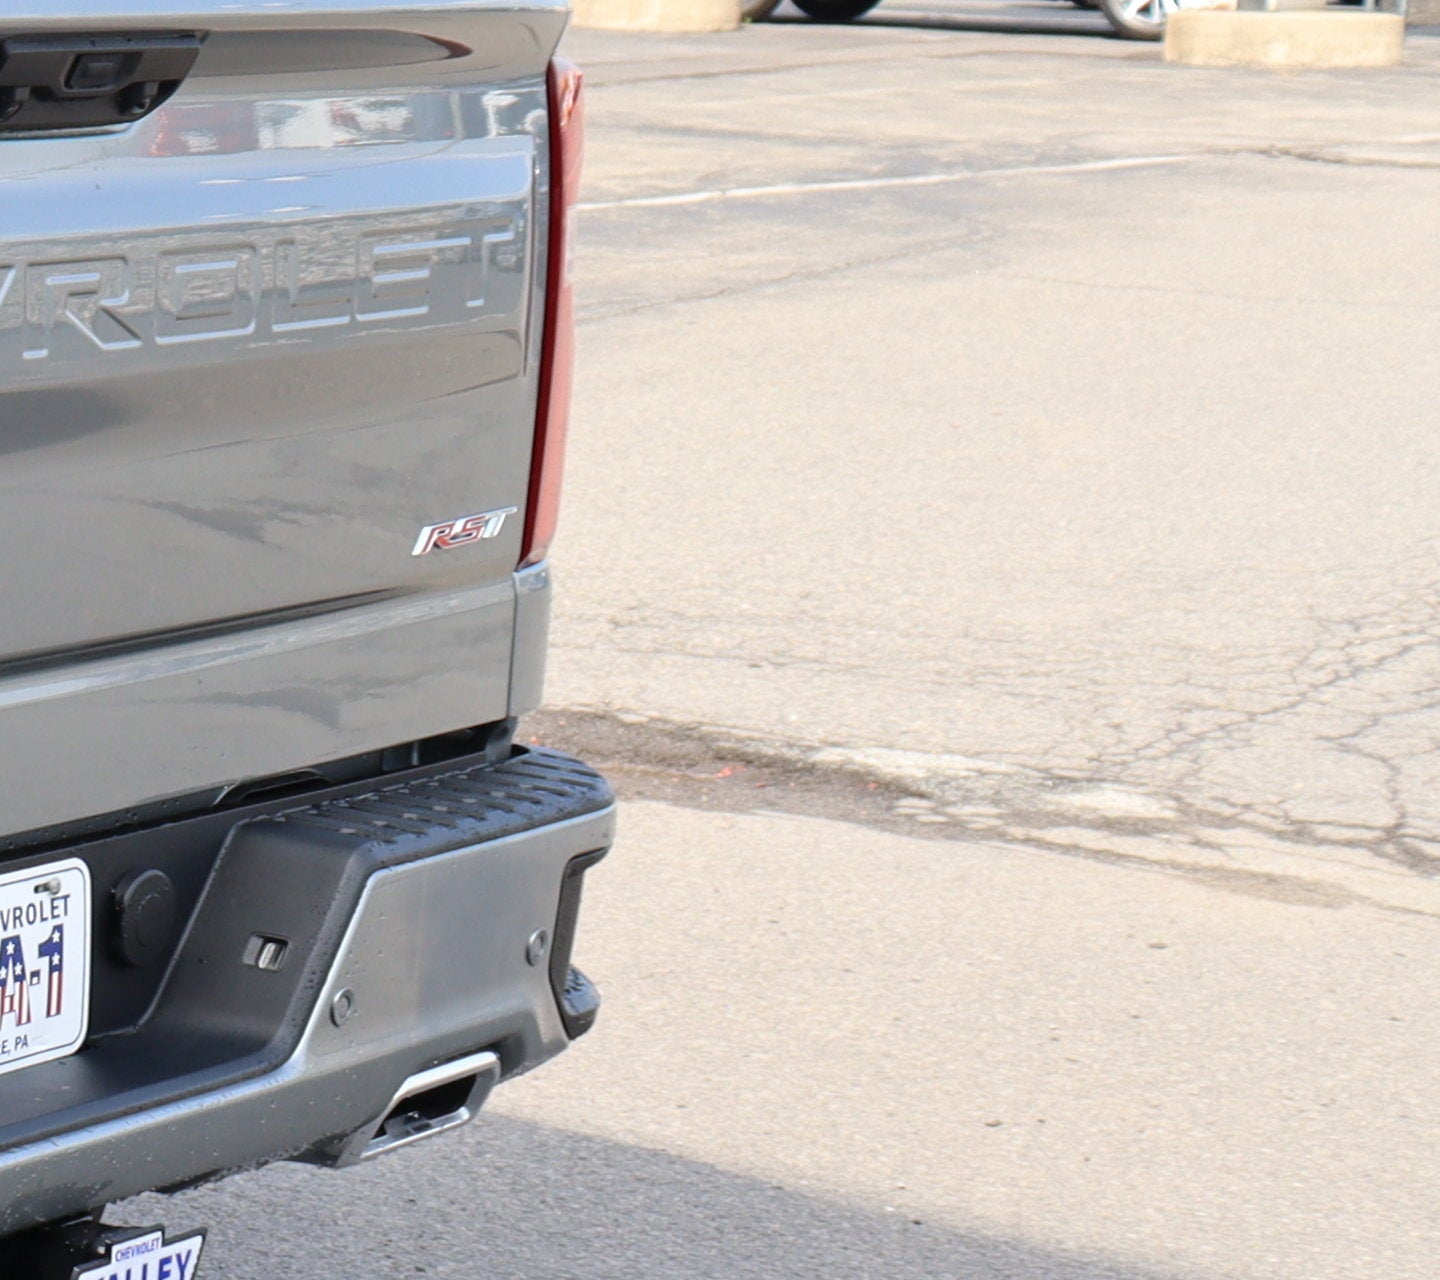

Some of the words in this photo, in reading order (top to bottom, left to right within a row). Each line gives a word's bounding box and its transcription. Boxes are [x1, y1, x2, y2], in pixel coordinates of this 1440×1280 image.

[411, 506, 518, 556] RST
[13, 1033, 30, 1053] PA
[115, 1237, 161, 1262] CHEVROLET
